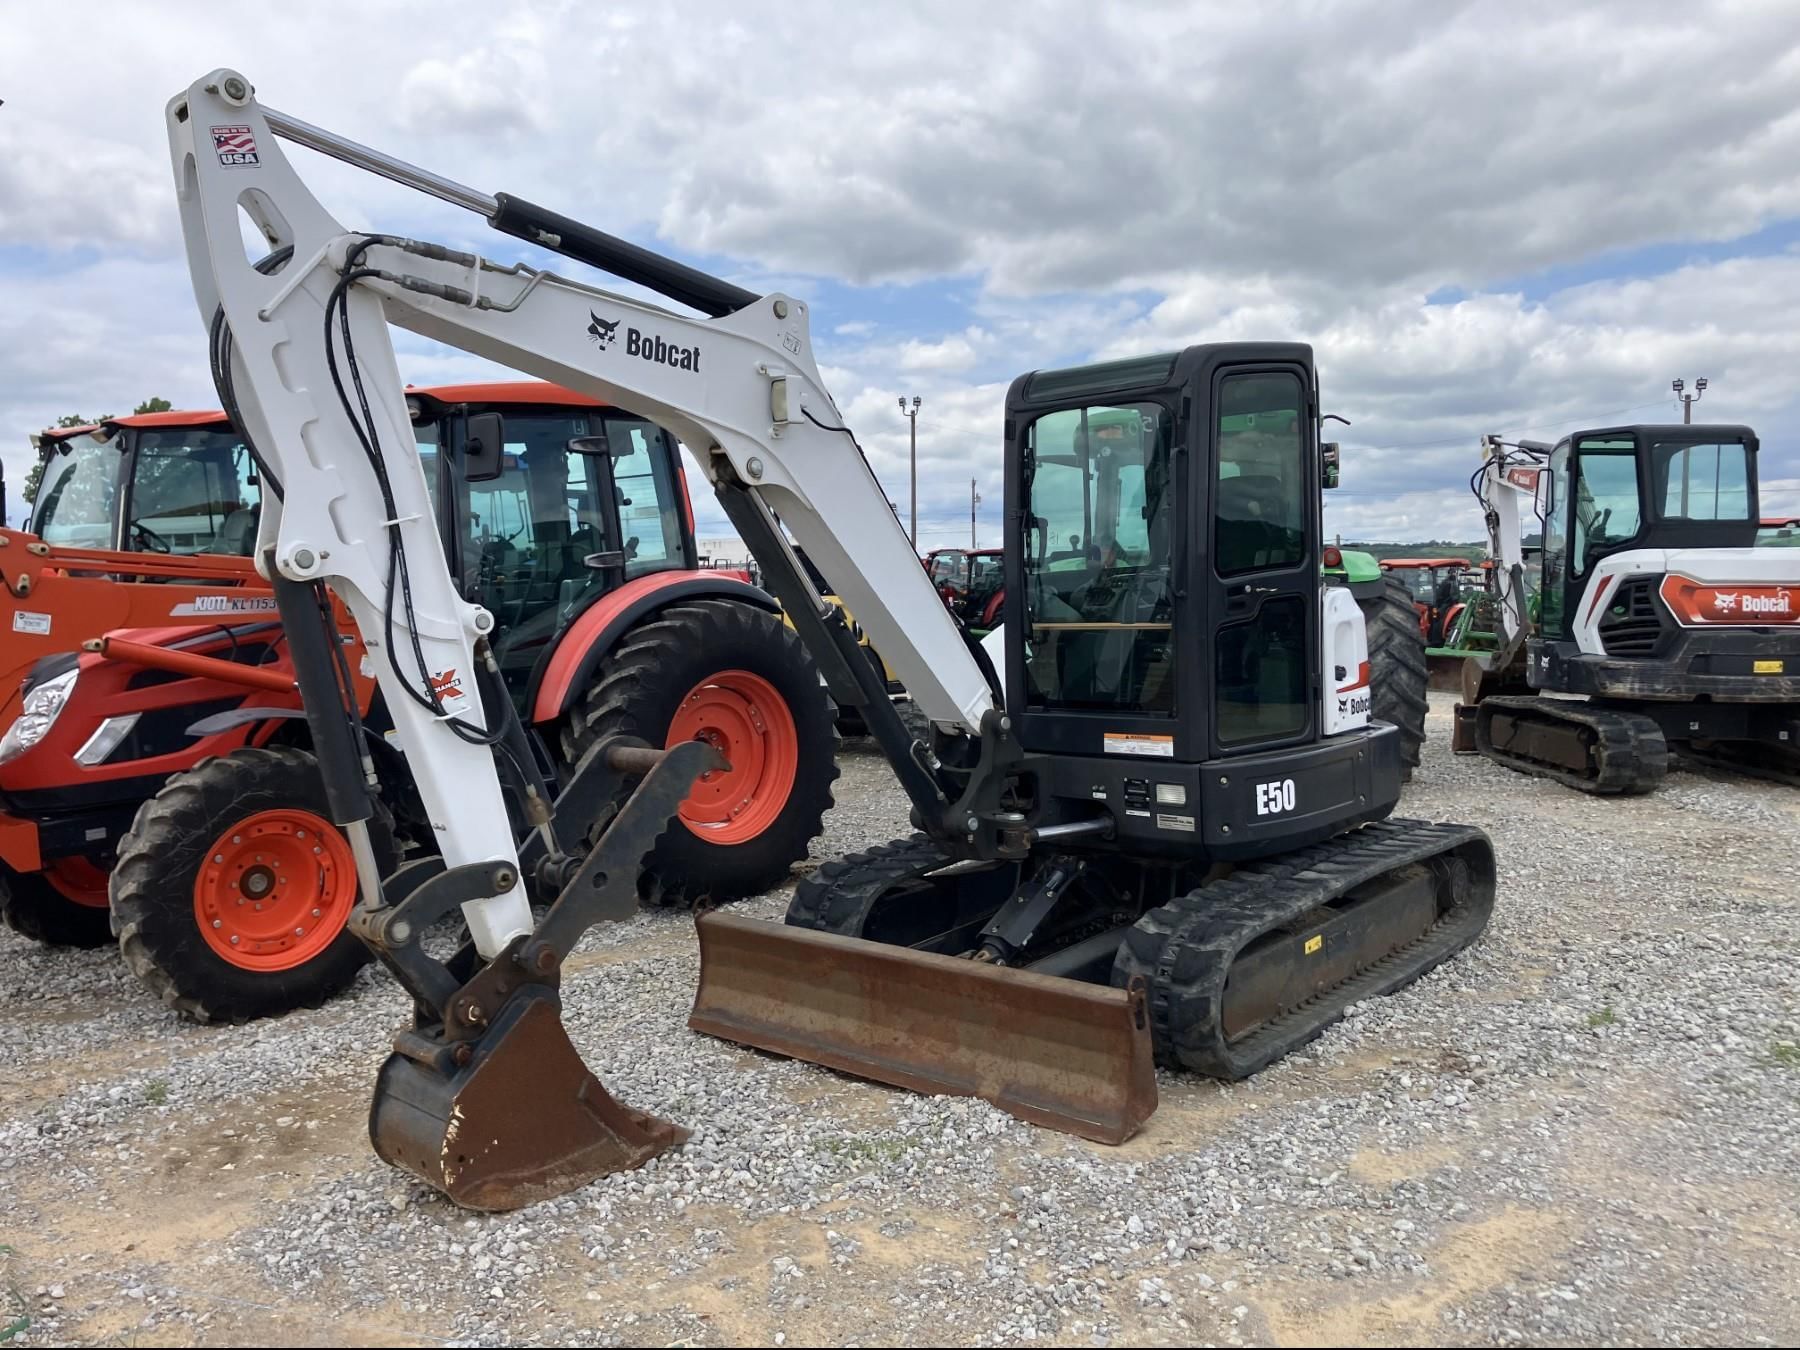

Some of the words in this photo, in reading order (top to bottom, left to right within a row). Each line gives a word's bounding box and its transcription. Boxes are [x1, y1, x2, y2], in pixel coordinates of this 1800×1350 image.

[221, 153, 257, 164] USA
[626, 327, 701, 373] Bobcat
[194, 596, 227, 611] KIOTI
[1742, 594, 1790, 613] Bobcat
[1256, 779, 1295, 815] E50
